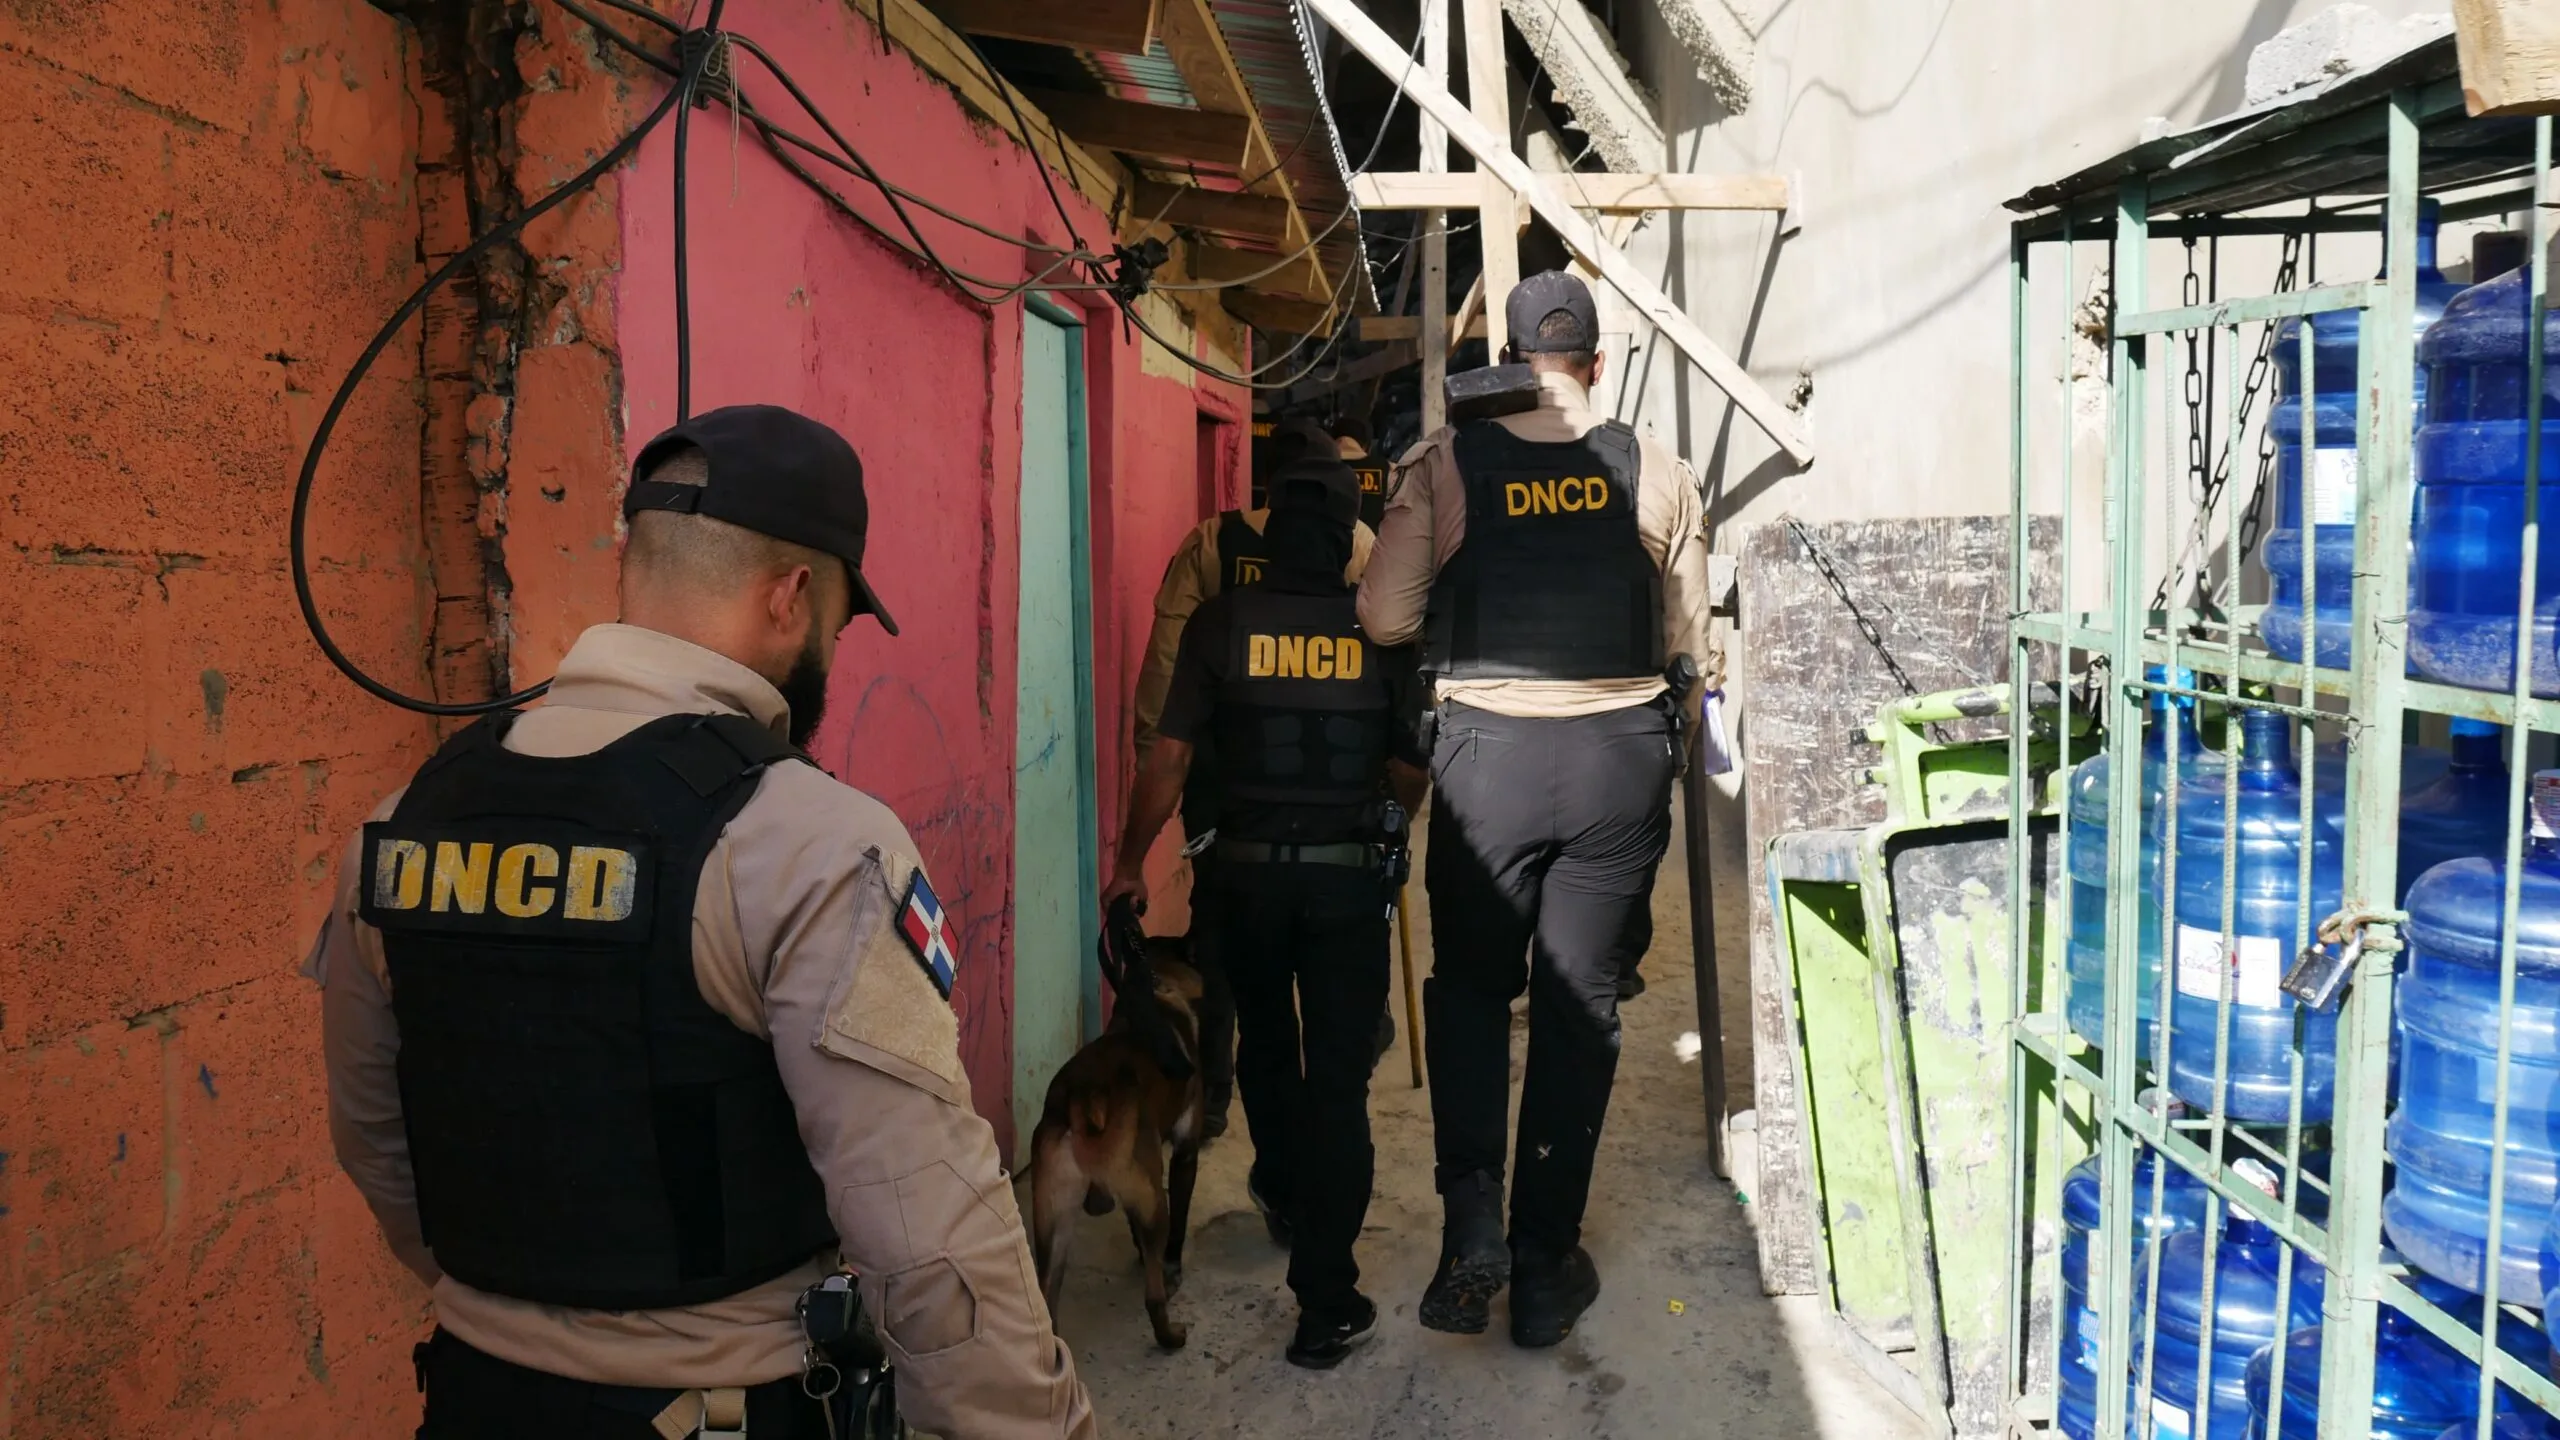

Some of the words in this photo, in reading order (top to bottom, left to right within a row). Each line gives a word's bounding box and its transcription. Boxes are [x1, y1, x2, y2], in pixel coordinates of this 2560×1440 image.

[1505, 476, 1608, 516] DNCD
[1248, 634, 1362, 680] DNCD
[373, 838, 637, 922] DNCD
